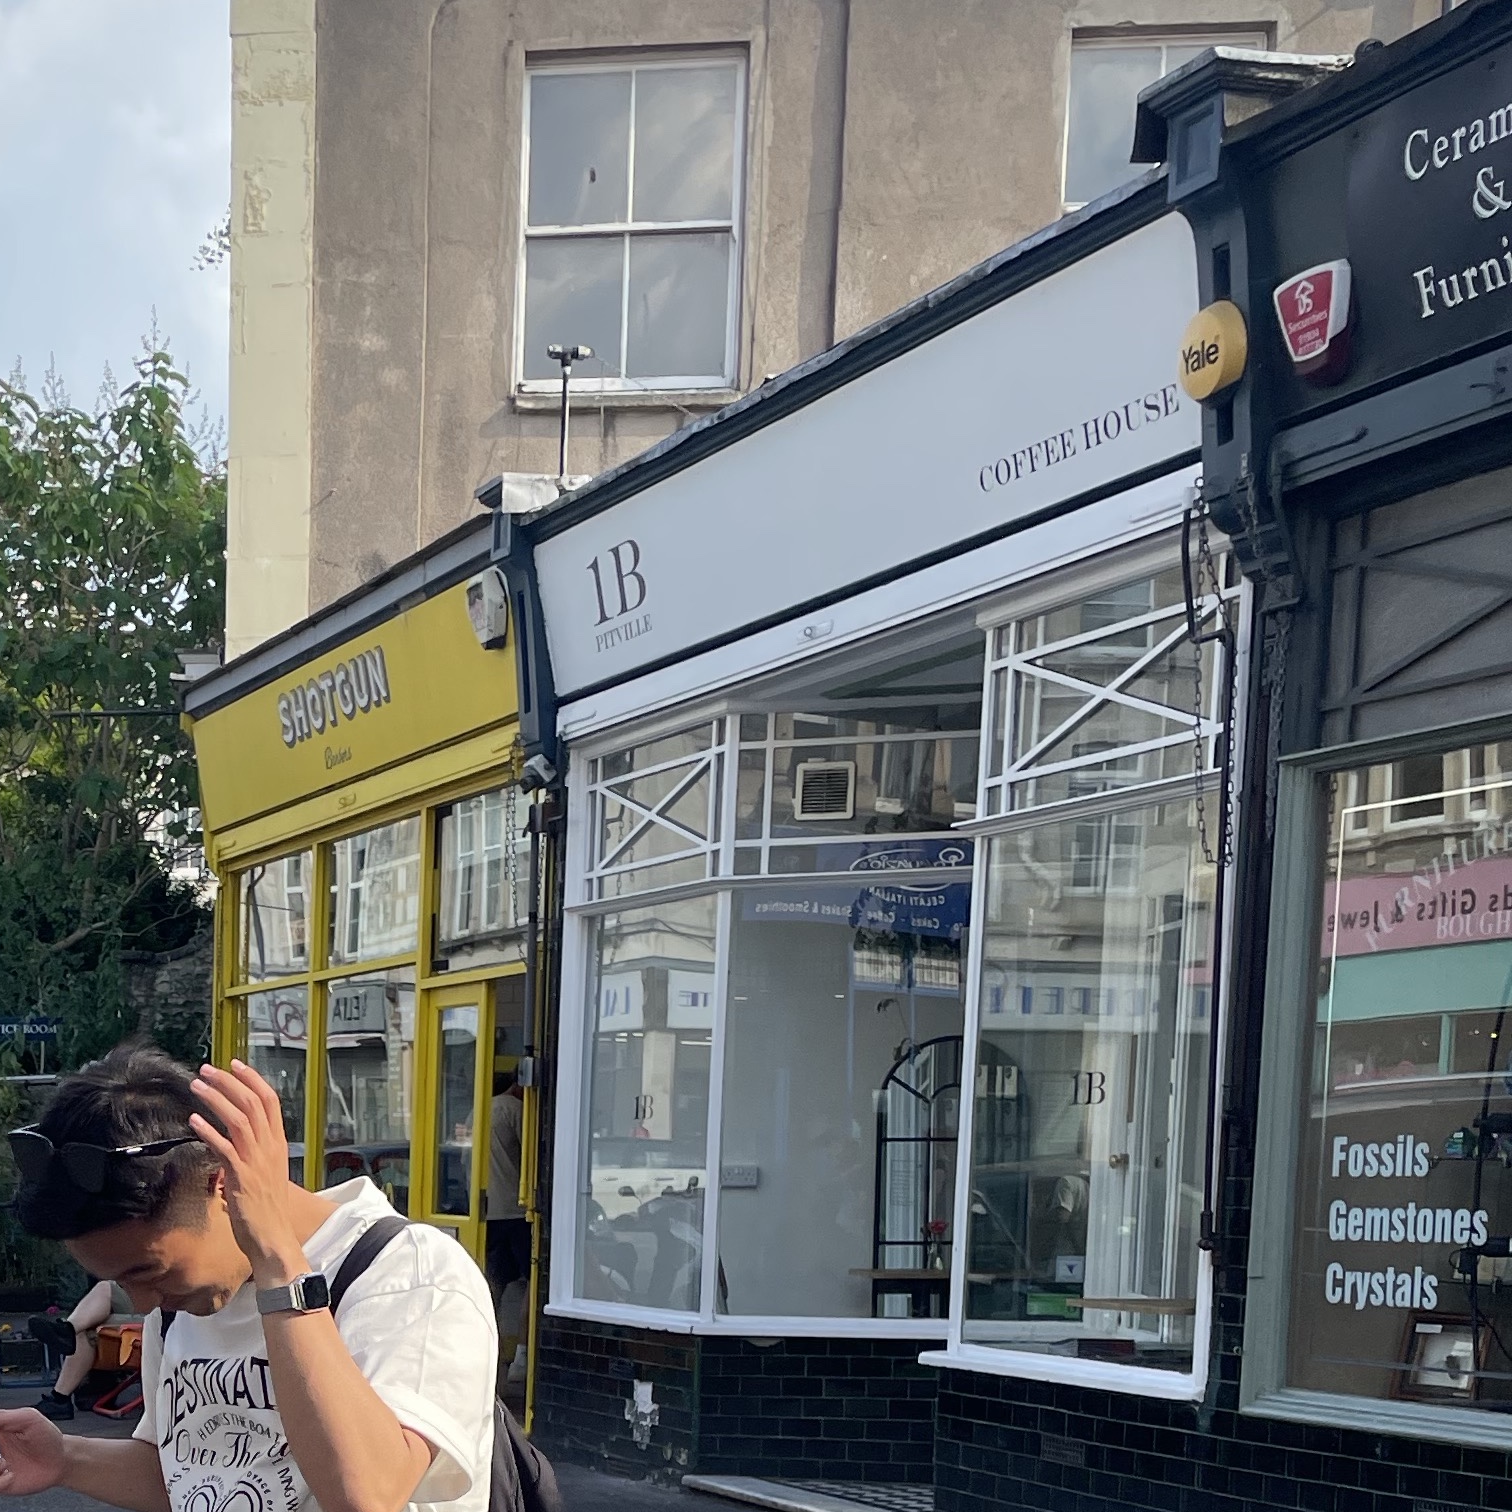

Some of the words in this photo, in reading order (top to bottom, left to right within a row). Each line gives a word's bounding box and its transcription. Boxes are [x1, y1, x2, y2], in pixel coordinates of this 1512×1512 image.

[1472, 166, 1512, 218] &
[1182, 339, 1219, 375] Yale
[979, 428, 1077, 492] COFFEE
[1081, 383, 1180, 451] HOUSE
[586, 539, 646, 627] 1B
[596, 613, 653, 653] PITVILLE
[278, 645, 391, 749] SHOTGUN
[1070, 1071, 1106, 1106] 1B
[1331, 1134, 1430, 1178] Fossils
[1328, 1199, 1489, 1246] Gemstones
[1325, 1262, 1438, 1310] Crystals
[174, 1428, 219, 1467] Over
